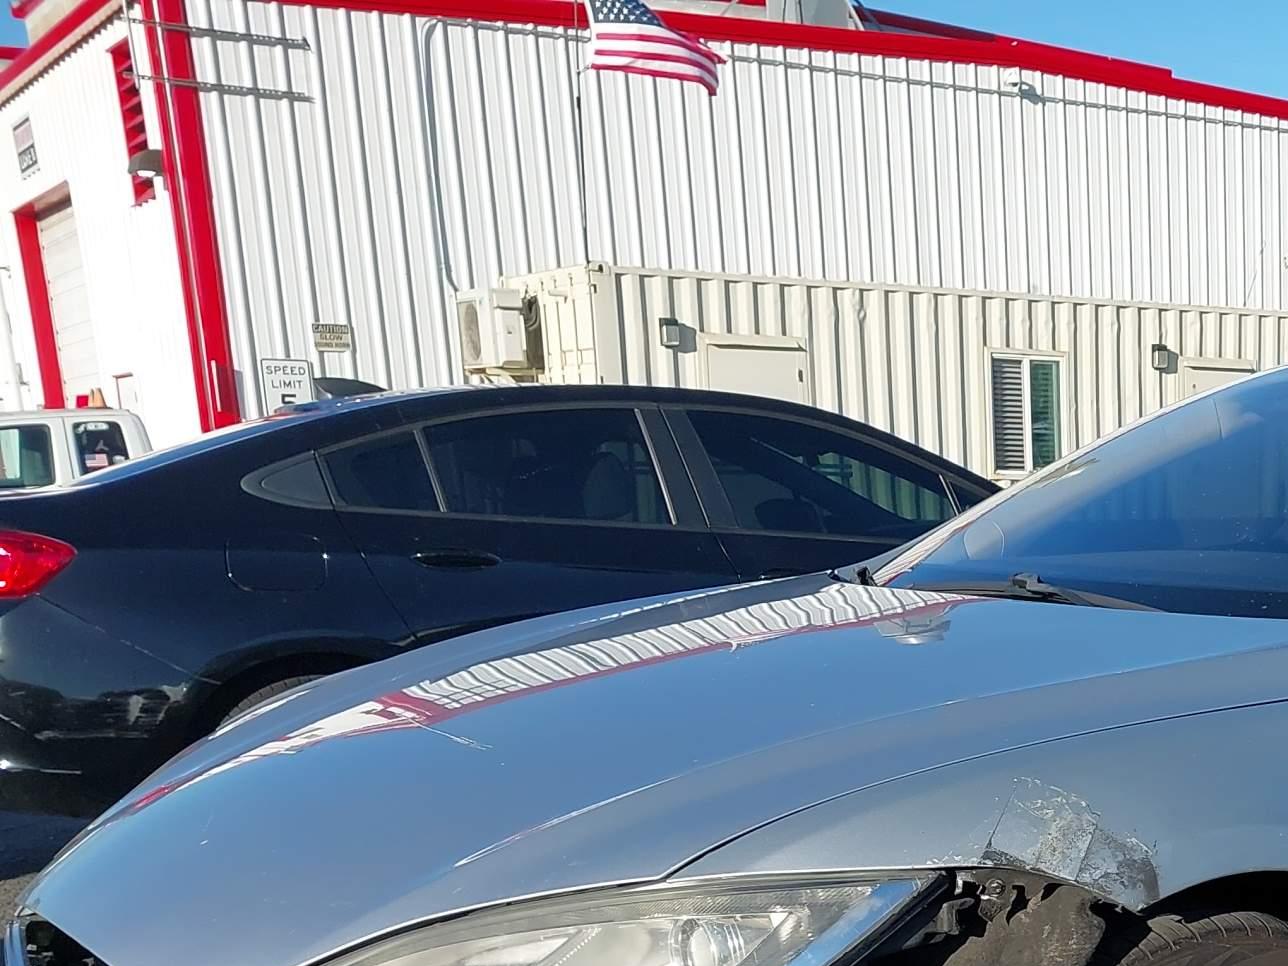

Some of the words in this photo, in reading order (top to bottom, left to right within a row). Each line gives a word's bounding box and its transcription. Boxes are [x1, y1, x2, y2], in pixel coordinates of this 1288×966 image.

[313, 325, 348, 334] CAUTION
[265, 365, 306, 375] SPEED
[271, 380, 303, 389] LIMIT
